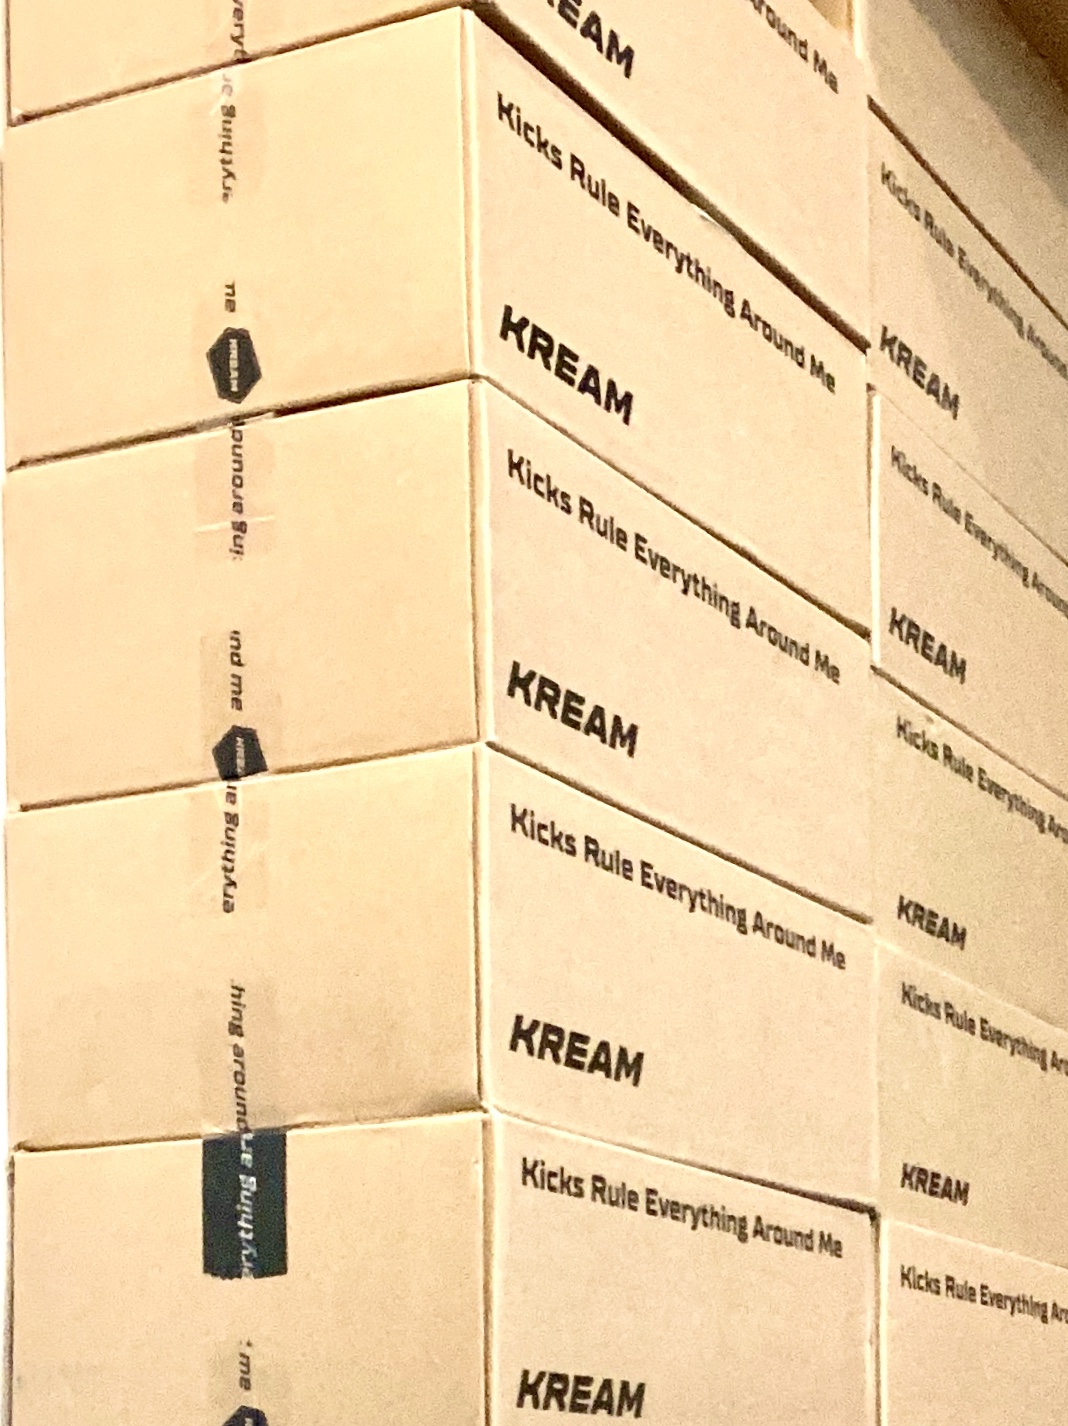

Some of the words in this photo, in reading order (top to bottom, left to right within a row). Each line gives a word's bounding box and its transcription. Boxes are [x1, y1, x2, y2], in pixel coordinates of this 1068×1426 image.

[548, 0, 635, 79] EAM
[813, 49, 839, 95] Me
[497, 91, 562, 170] Kicks
[570, 152, 619, 217] Rule
[627, 201, 736, 318] Everything
[740, 298, 805, 368] Around
[810, 354, 835, 395] Me
[500, 304, 635, 426] KREAM
[879, 324, 960, 420] KREAM
[229, 521, 249, 561] ing
[507, 449, 572, 514] Kicks
[579, 496, 627, 552] Rule
[635, 534, 741, 629] Everything
[745, 606, 809, 667] Around
[815, 651, 841, 685] Me
[889, 606, 967, 685] KREAM
[230, 673, 244, 713] me
[507, 661, 640, 758] KREAM
[897, 715, 939, 760] Kicks
[510, 803, 577, 857] Kicks
[584, 835, 633, 881] Rule
[640, 861, 748, 934] Everything
[752, 911, 817, 958] Around
[821, 940, 846, 970] Me
[897, 894, 968, 951] KREAM
[228, 979, 246, 1038] hing
[901, 982, 942, 1021] Kicks
[944, 1001, 976, 1036] Rule
[509, 1014, 645, 1087] KREAM
[521, 1157, 584, 1199] Kicks
[591, 1174, 639, 1212] Rule
[645, 1187, 748, 1243] Everything
[752, 1215, 814, 1252] Around
[819, 1230, 843, 1259] Me
[900, 1163, 970, 1206] KREAM
[900, 1264, 941, 1296] Kicks
[944, 1274, 976, 1304] Rule
[980, 1283, 1048, 1324] Everything
[239, 1352, 252, 1391] me
[516, 1369, 646, 1419] KREAM
